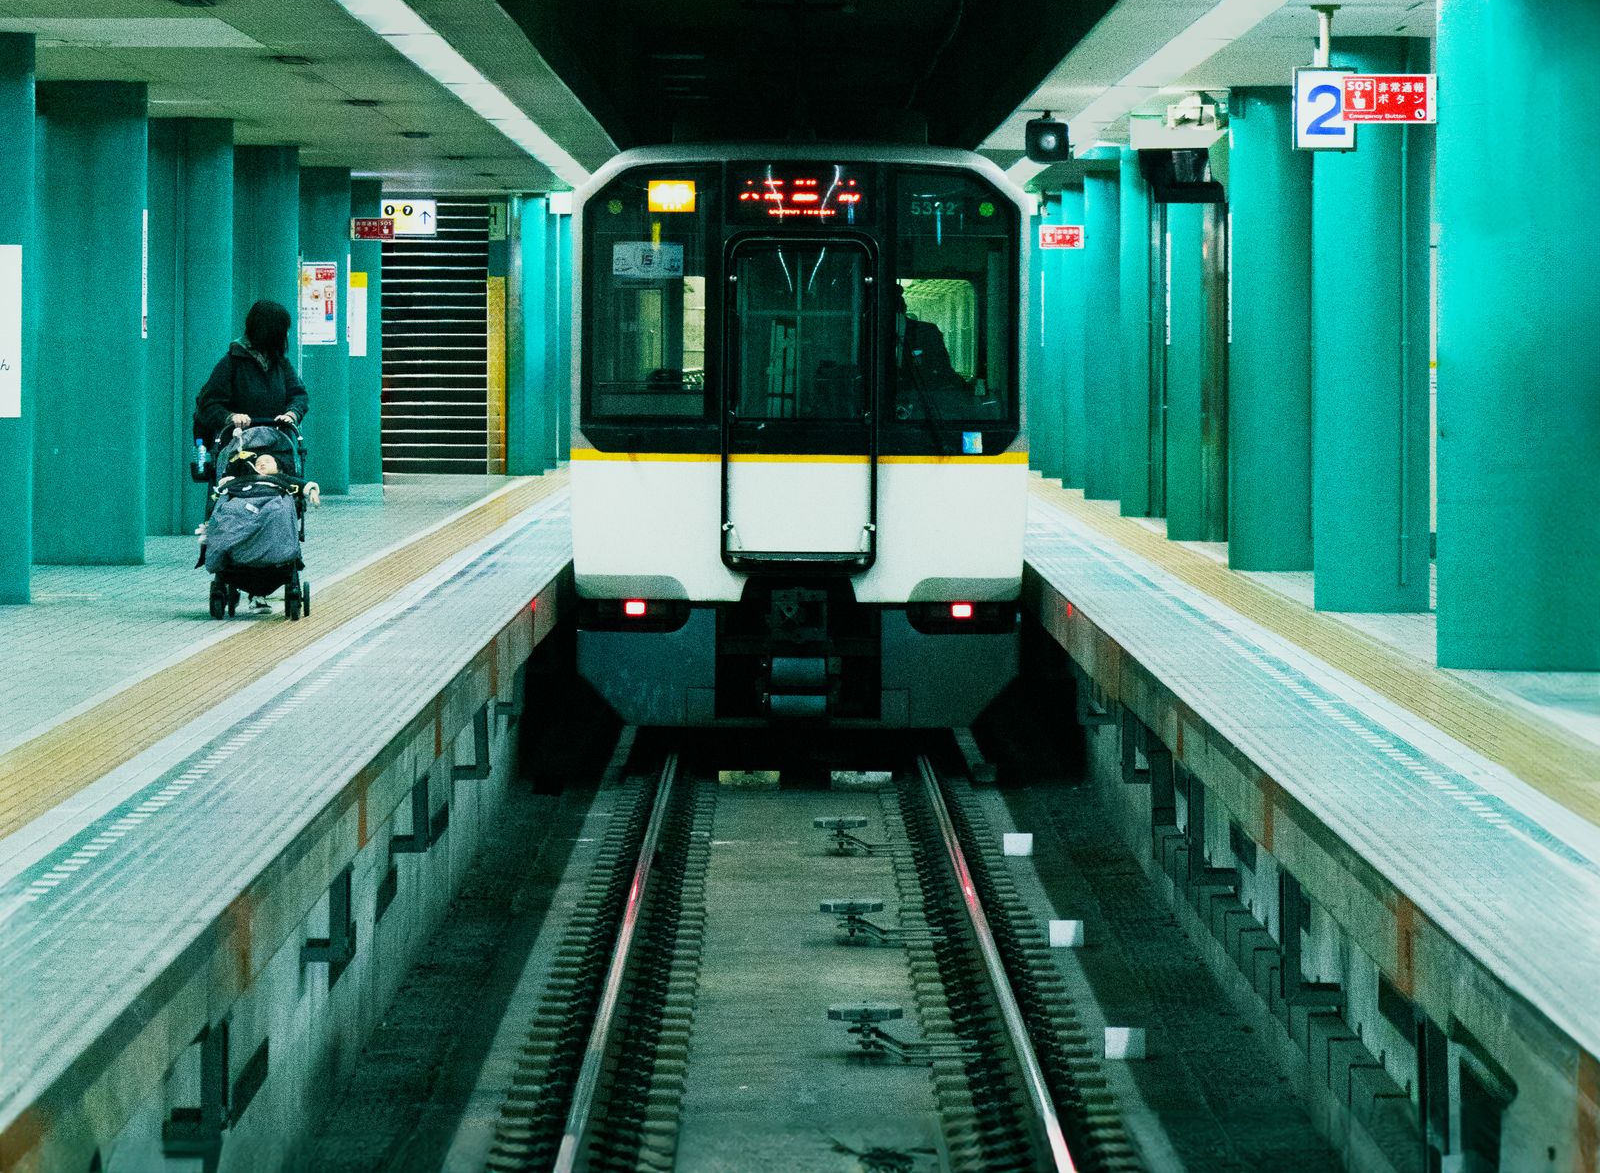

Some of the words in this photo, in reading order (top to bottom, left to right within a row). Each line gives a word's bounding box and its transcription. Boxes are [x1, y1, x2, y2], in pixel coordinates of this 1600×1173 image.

[1346, 81, 1372, 91] SOS
[1378, 82, 1424, 93] 非常通報
[1378, 94, 1424, 105] ボタン
[1305, 84, 1346, 136] 2
[385, 206, 394, 215] 1
[403, 206, 412, 215] 7
